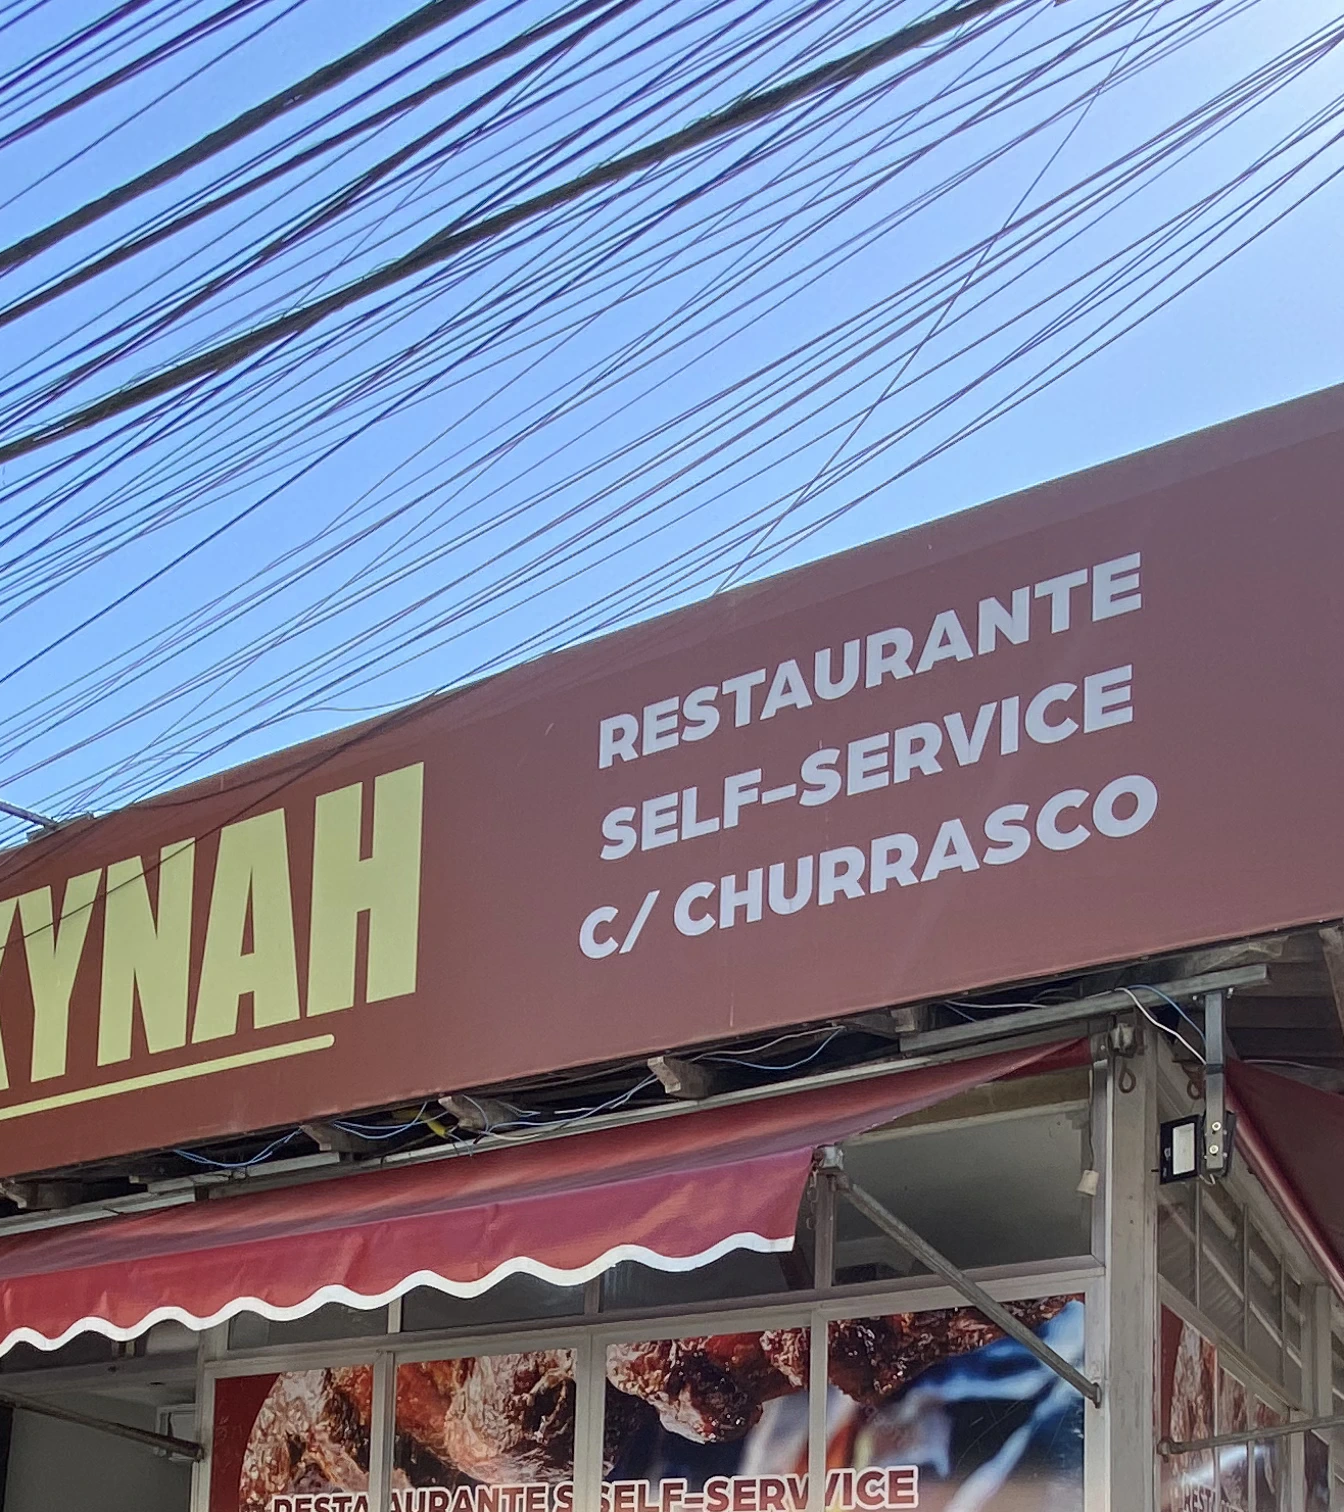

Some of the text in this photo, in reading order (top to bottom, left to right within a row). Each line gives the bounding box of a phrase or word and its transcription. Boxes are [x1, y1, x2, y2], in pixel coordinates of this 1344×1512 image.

[597, 551, 1142, 769] RESTAURANTE
[600, 664, 1134, 861] SELF-SERVICE
[578, 774, 1158, 959] C/ CHURRASCO
